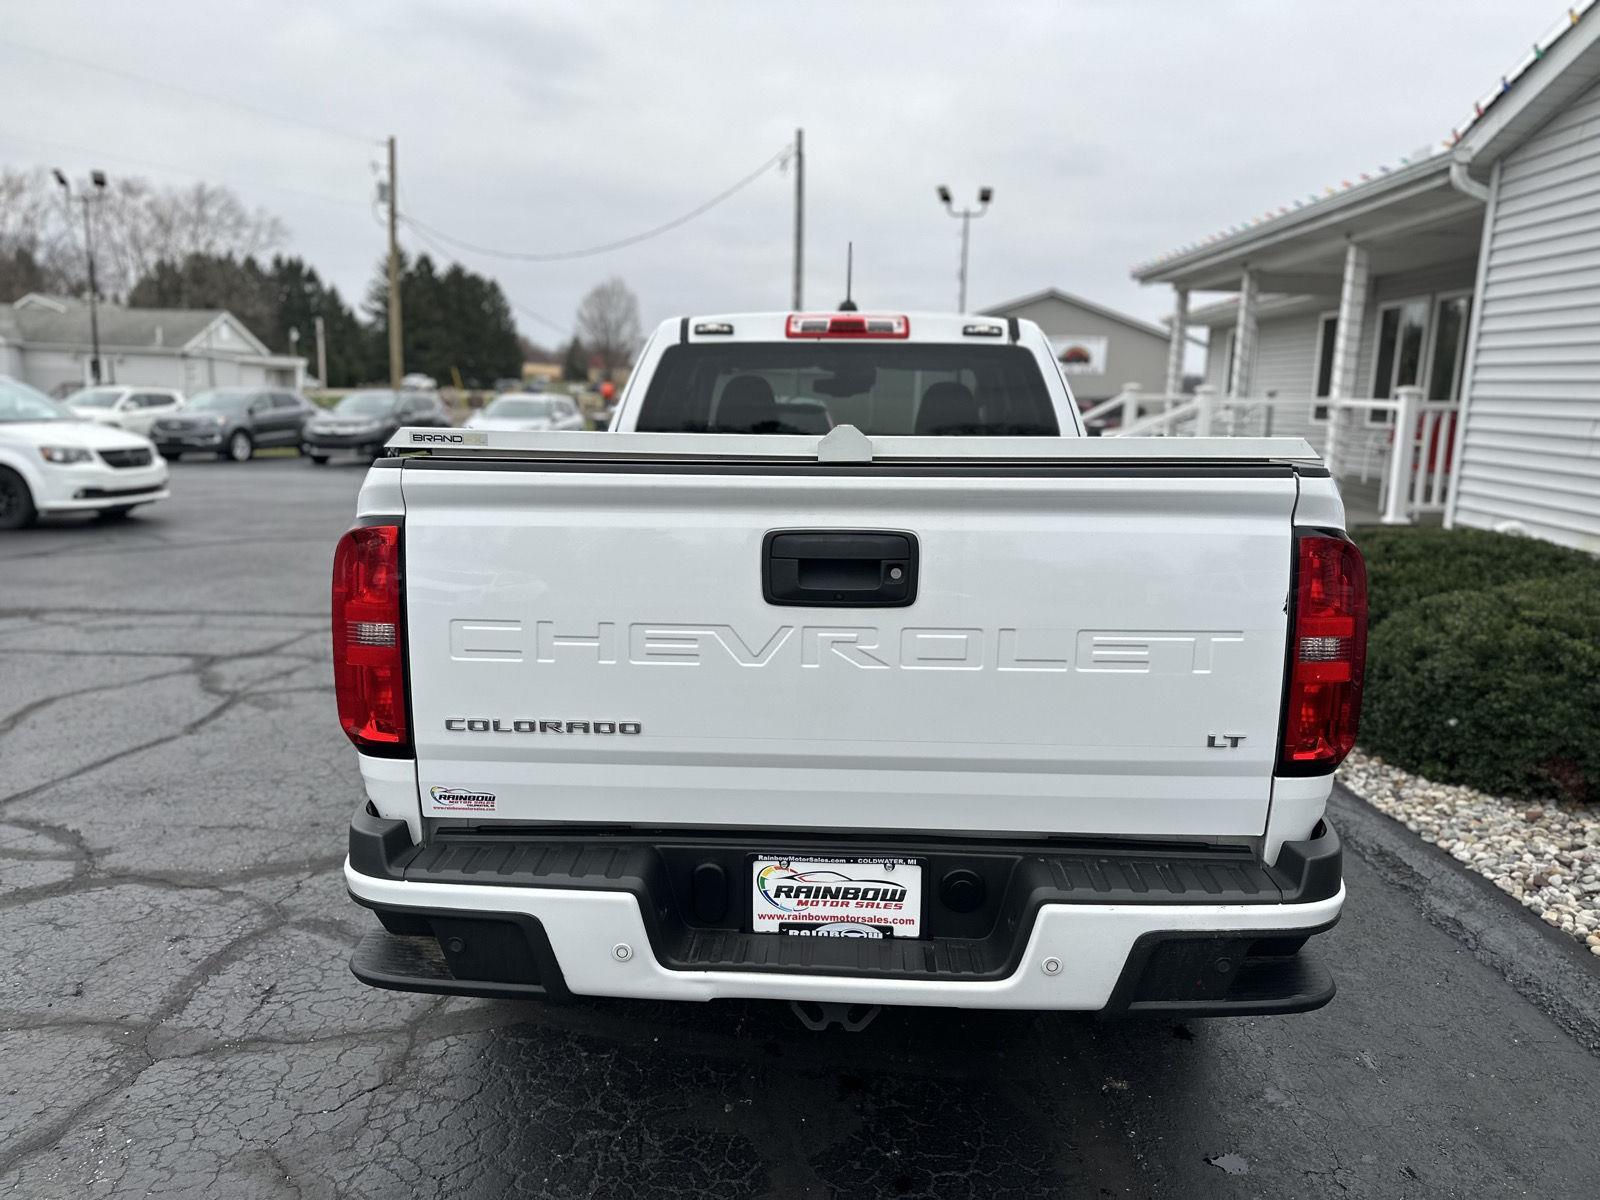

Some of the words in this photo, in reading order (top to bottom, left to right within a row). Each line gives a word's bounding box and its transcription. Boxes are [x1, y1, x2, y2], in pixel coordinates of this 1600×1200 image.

[449, 618, 1244, 674] CHEVROLET
[445, 718, 642, 735] COLORADO
[1207, 733, 1247, 748] LT
[758, 854, 846, 863] RainbowMotorSales.com
[773, 884, 908, 903] RAINBOW
[796, 899, 850, 908] MOTOR
[854, 901, 904, 910] SALES
[757, 912, 915, 926] www.rainbowmotorsales.com
